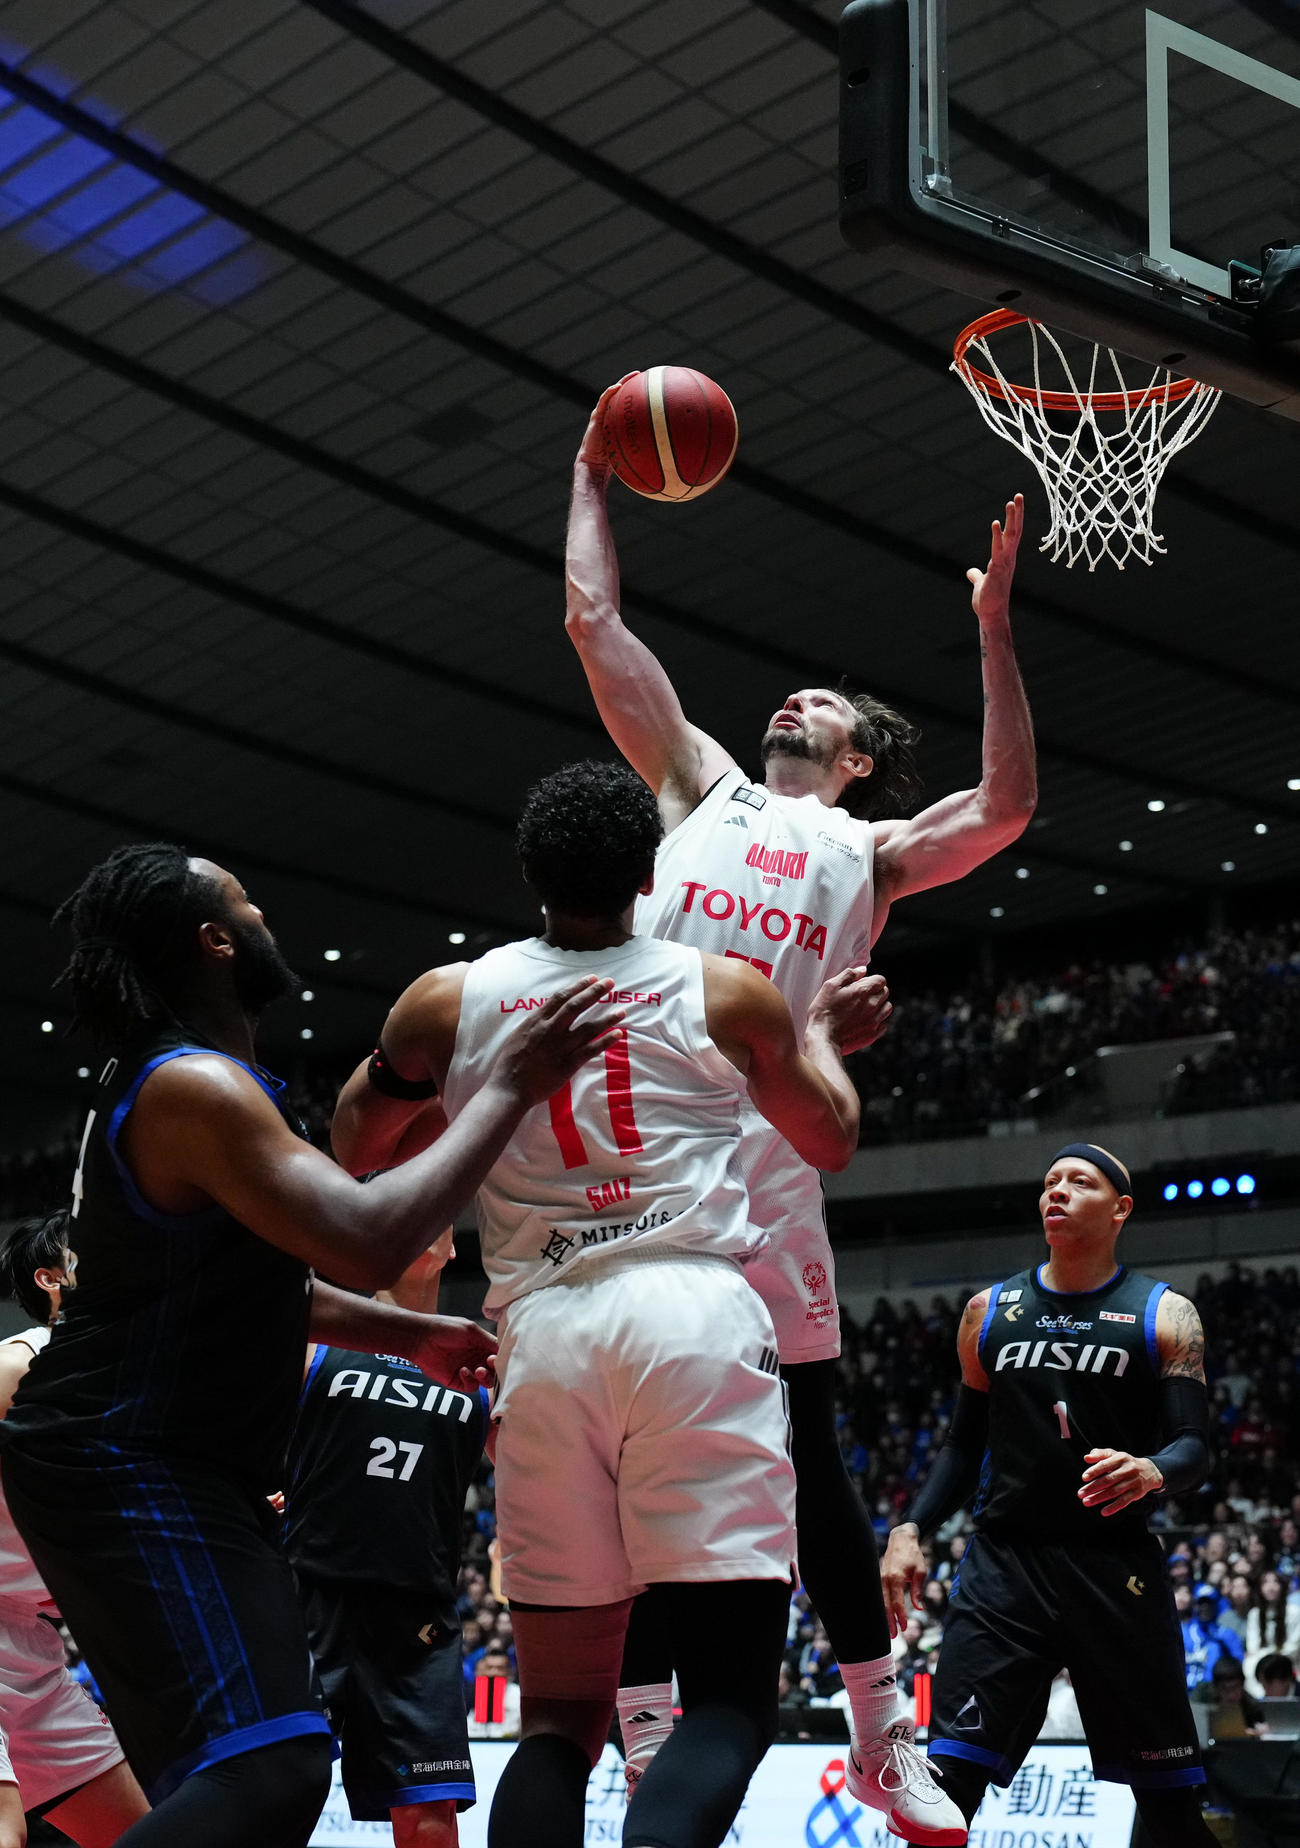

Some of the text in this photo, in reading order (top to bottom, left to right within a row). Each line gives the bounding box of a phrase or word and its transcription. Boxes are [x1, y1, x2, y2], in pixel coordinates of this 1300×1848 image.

[745, 843, 809, 880] ALVARK
[681, 881, 828, 961] TOYOTA
[500, 997, 548, 1013] LAN
[806, 1308, 834, 1321] Olympics
[808, 1297, 830, 1310] Special
[994, 1340, 1130, 1377] AISIN
[327, 1369, 473, 1423] AISIN
[1052, 1400, 1071, 1439] 1
[366, 1436, 424, 1482] 27
